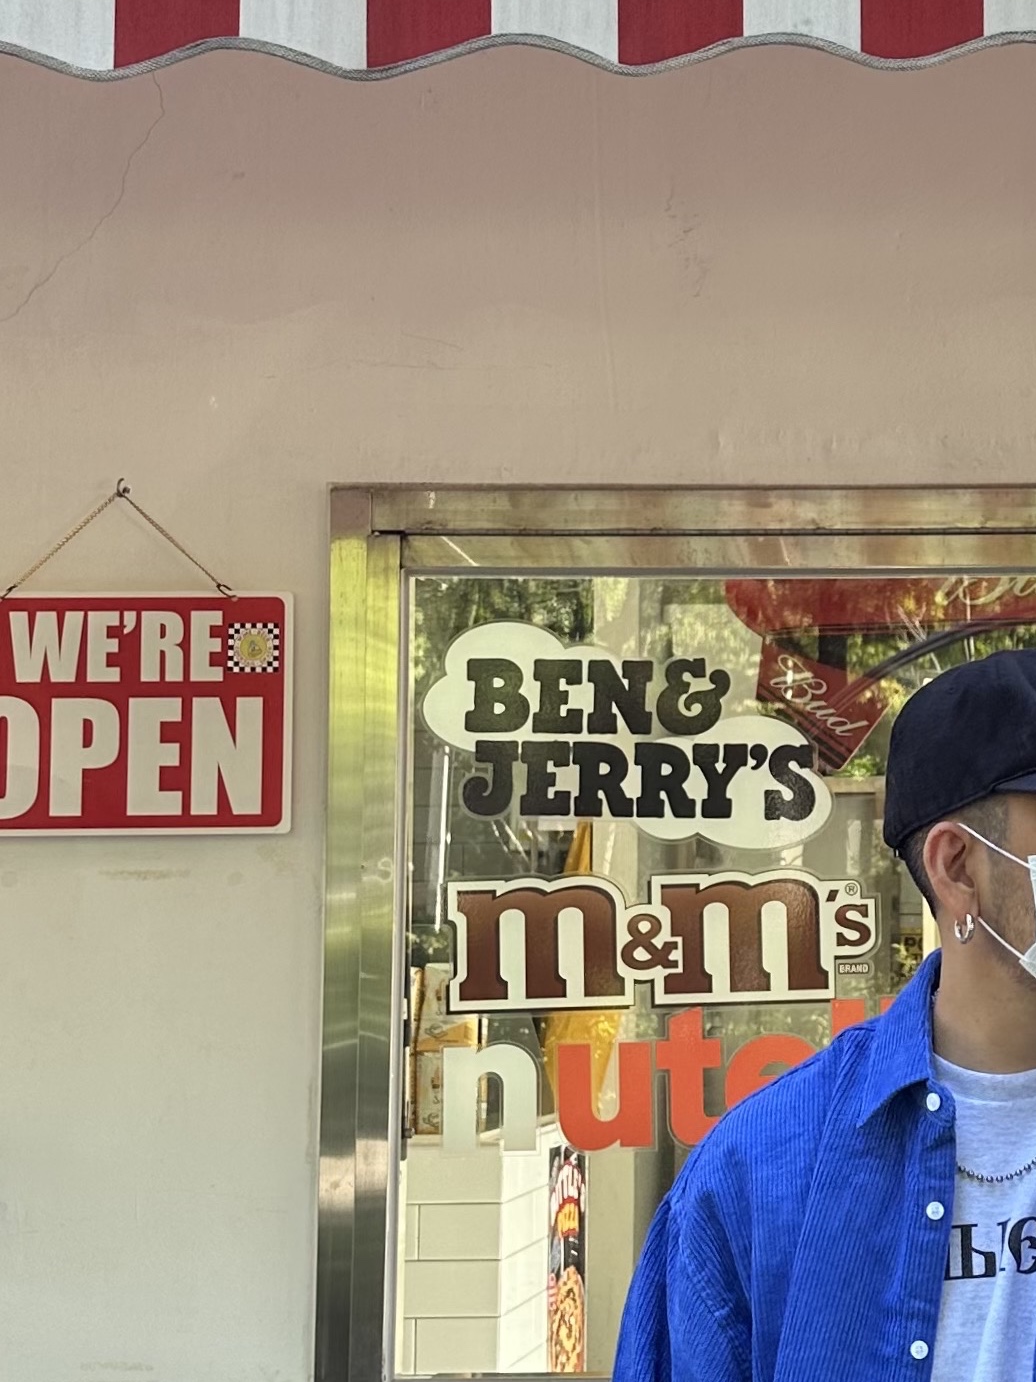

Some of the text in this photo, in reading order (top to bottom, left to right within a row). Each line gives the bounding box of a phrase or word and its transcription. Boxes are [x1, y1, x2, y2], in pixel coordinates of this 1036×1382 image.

[9, 611, 224, 683] WE'RE
[769, 654, 870, 736] Bud
[461, 740, 817, 822] JERRY'S
[839, 964, 869, 974] BRAND
